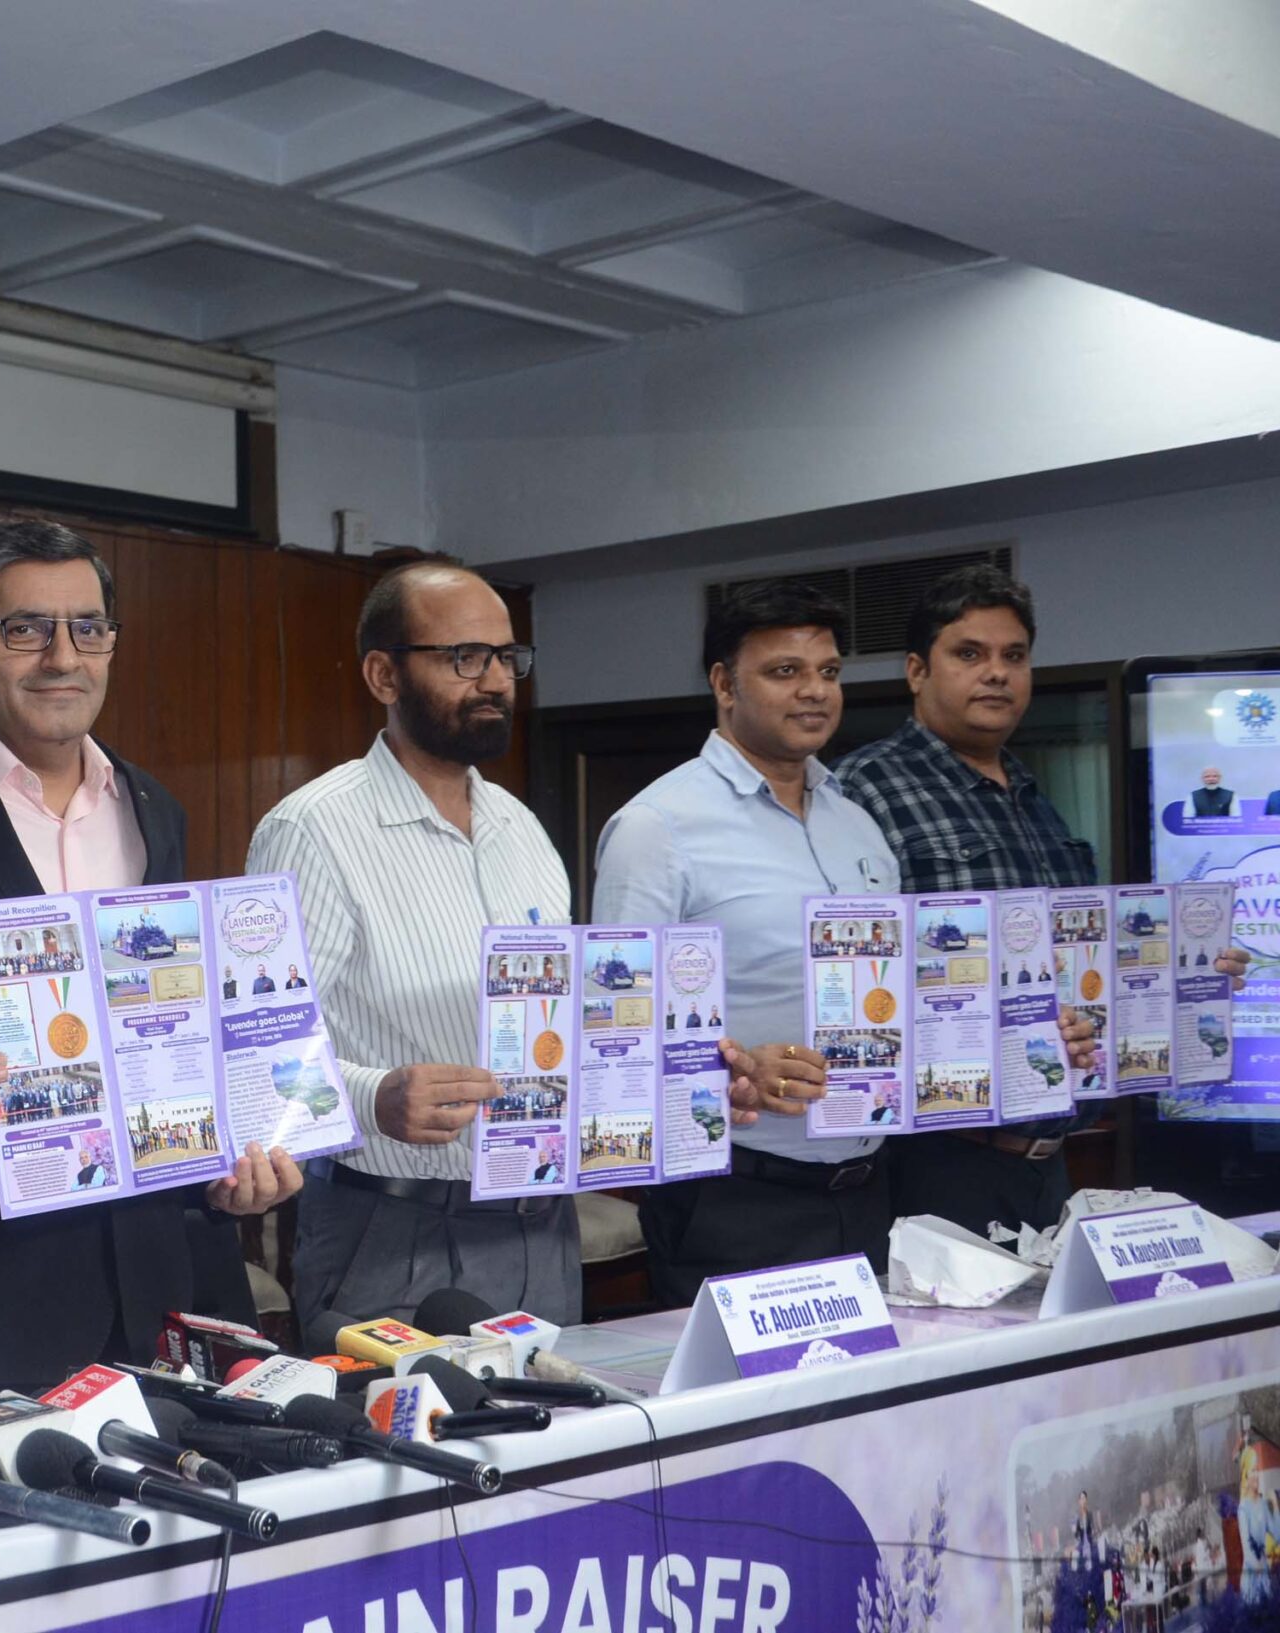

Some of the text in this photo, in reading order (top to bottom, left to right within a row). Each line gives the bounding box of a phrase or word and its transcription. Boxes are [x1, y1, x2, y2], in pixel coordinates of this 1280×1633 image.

[11, 903, 57, 915] Recognition
[849, 901, 887, 910] Recognition
[1233, 898, 1280, 918] AVE
[228, 913, 276, 929] LAVENDER
[232, 926, 275, 938] FESTIVAL-2026
[1235, 922, 1280, 936] ESTIV
[500, 933, 557, 942] National Recognition
[672, 958, 708, 970] LAVENDER
[1235, 983, 1280, 997] ende
[127, 1013, 186, 1026] PROGRAMME SCHEDULE
[258, 1015, 277, 1027] goes
[1265, 1015, 1279, 1024] BY
[226, 1050, 257, 1061] Bhaderwah
[1110, 1235, 1205, 1267] Sh. Kaushal Kumar
[749, 1309, 772, 1337] Er.
[769, 1299, 816, 1332] Abdul
[812, 1293, 863, 1325] Rahim
[250, 1360, 299, 1388] GLOBAL
[261, 1363, 313, 1392] MEDIA
[392, 1388, 408, 1438] OUNG
[495, 1553, 791, 1633] RAISER
